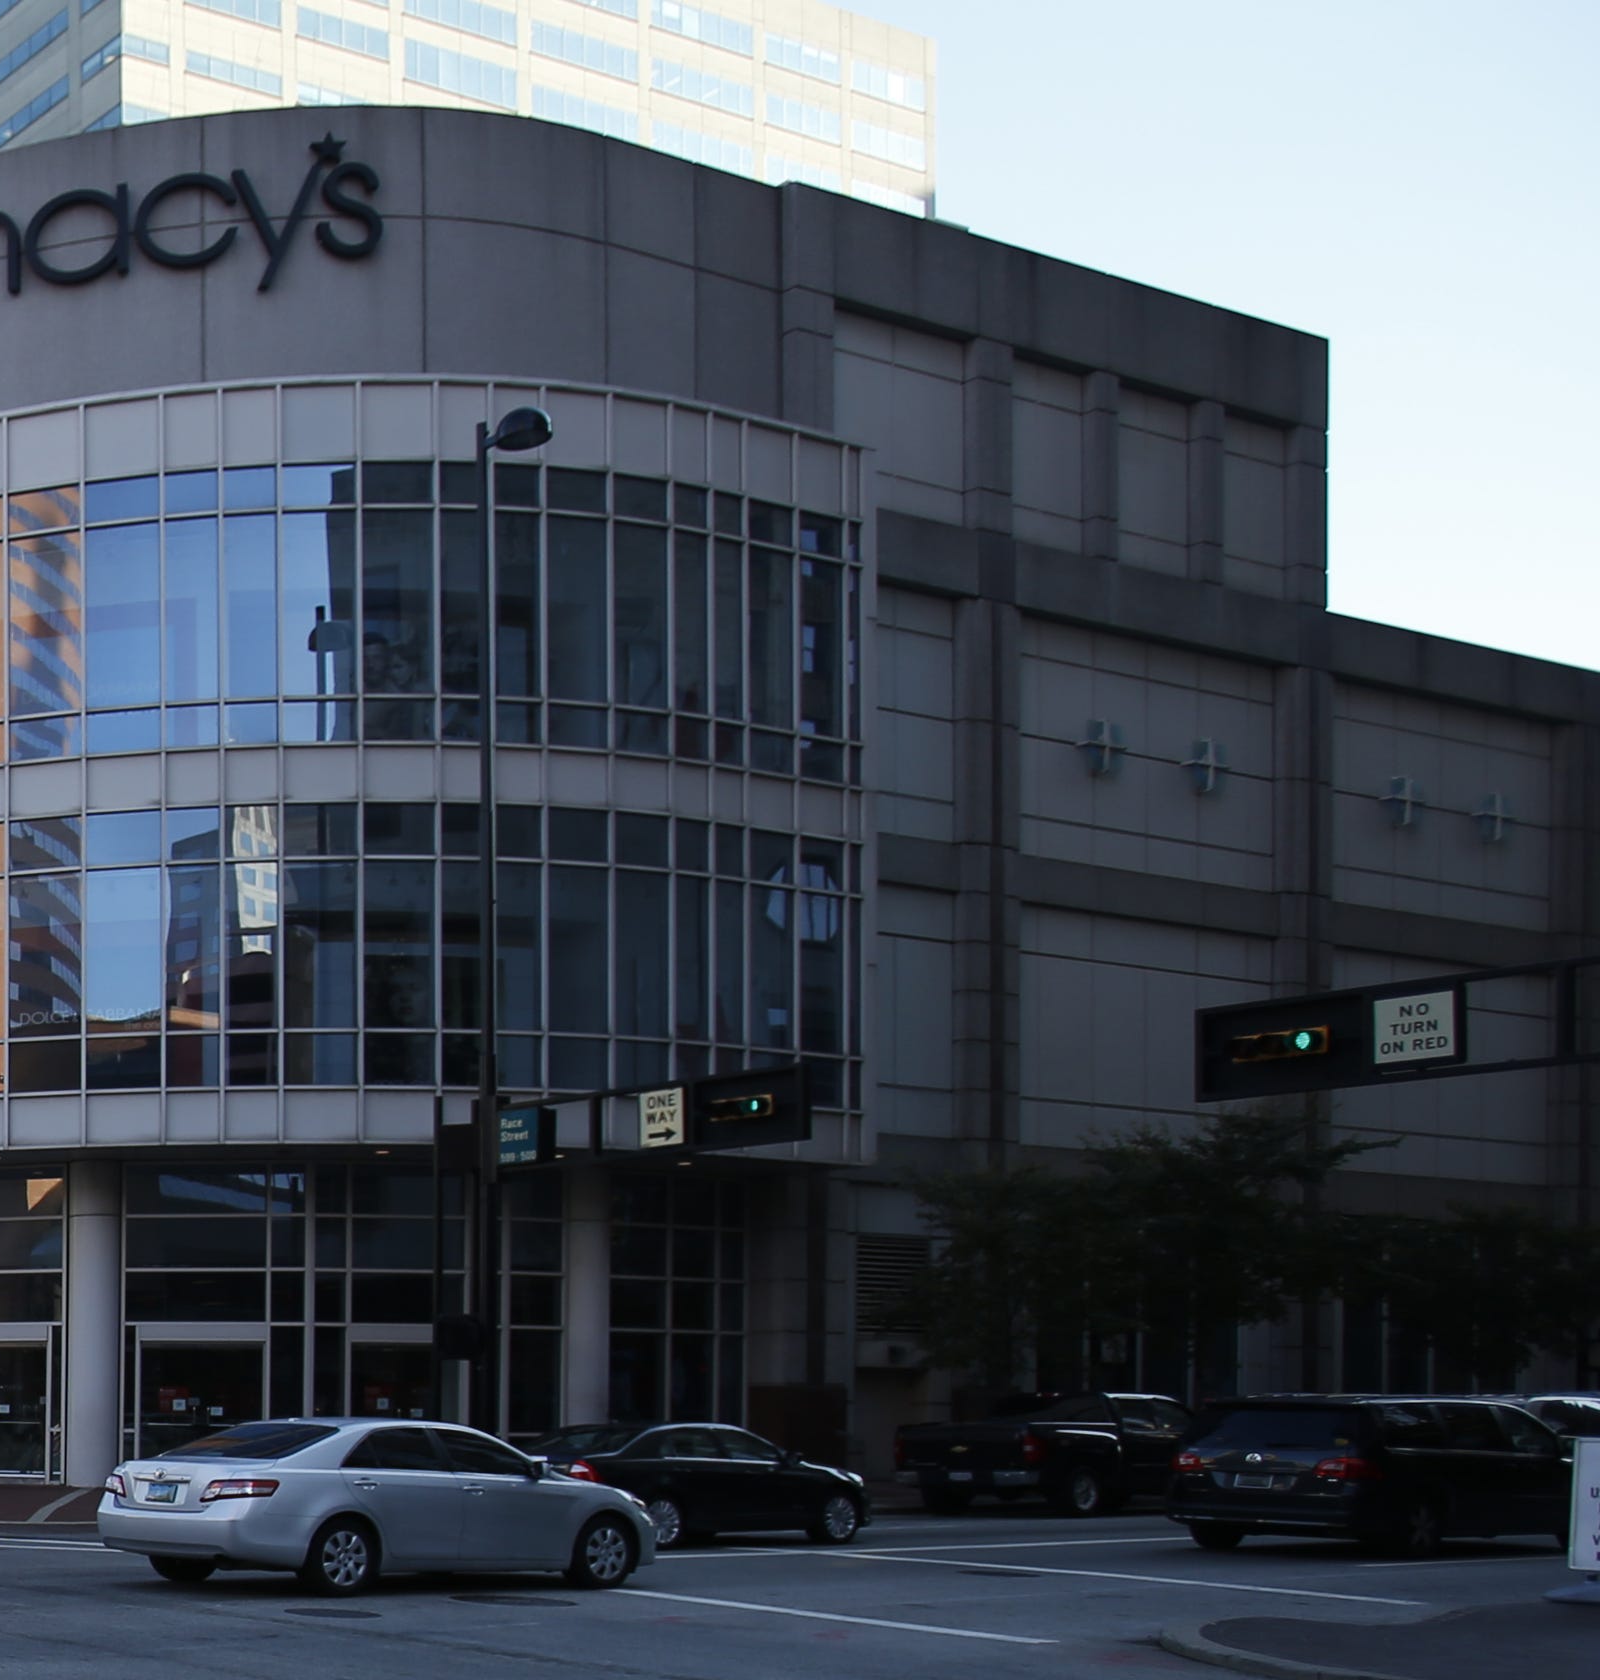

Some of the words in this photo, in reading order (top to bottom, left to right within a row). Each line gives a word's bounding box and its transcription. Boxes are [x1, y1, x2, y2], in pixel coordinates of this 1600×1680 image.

[1399, 1002, 1429, 1018] NO
[1390, 1019, 1438, 1036] TURN
[1380, 1041, 1404, 1055] ON
[1412, 1036, 1448, 1051] RED
[647, 1093, 677, 1110] ONE
[500, 1118, 524, 1129] Race
[645, 1108, 677, 1125] WAY
[500, 1130, 529, 1143] Street
